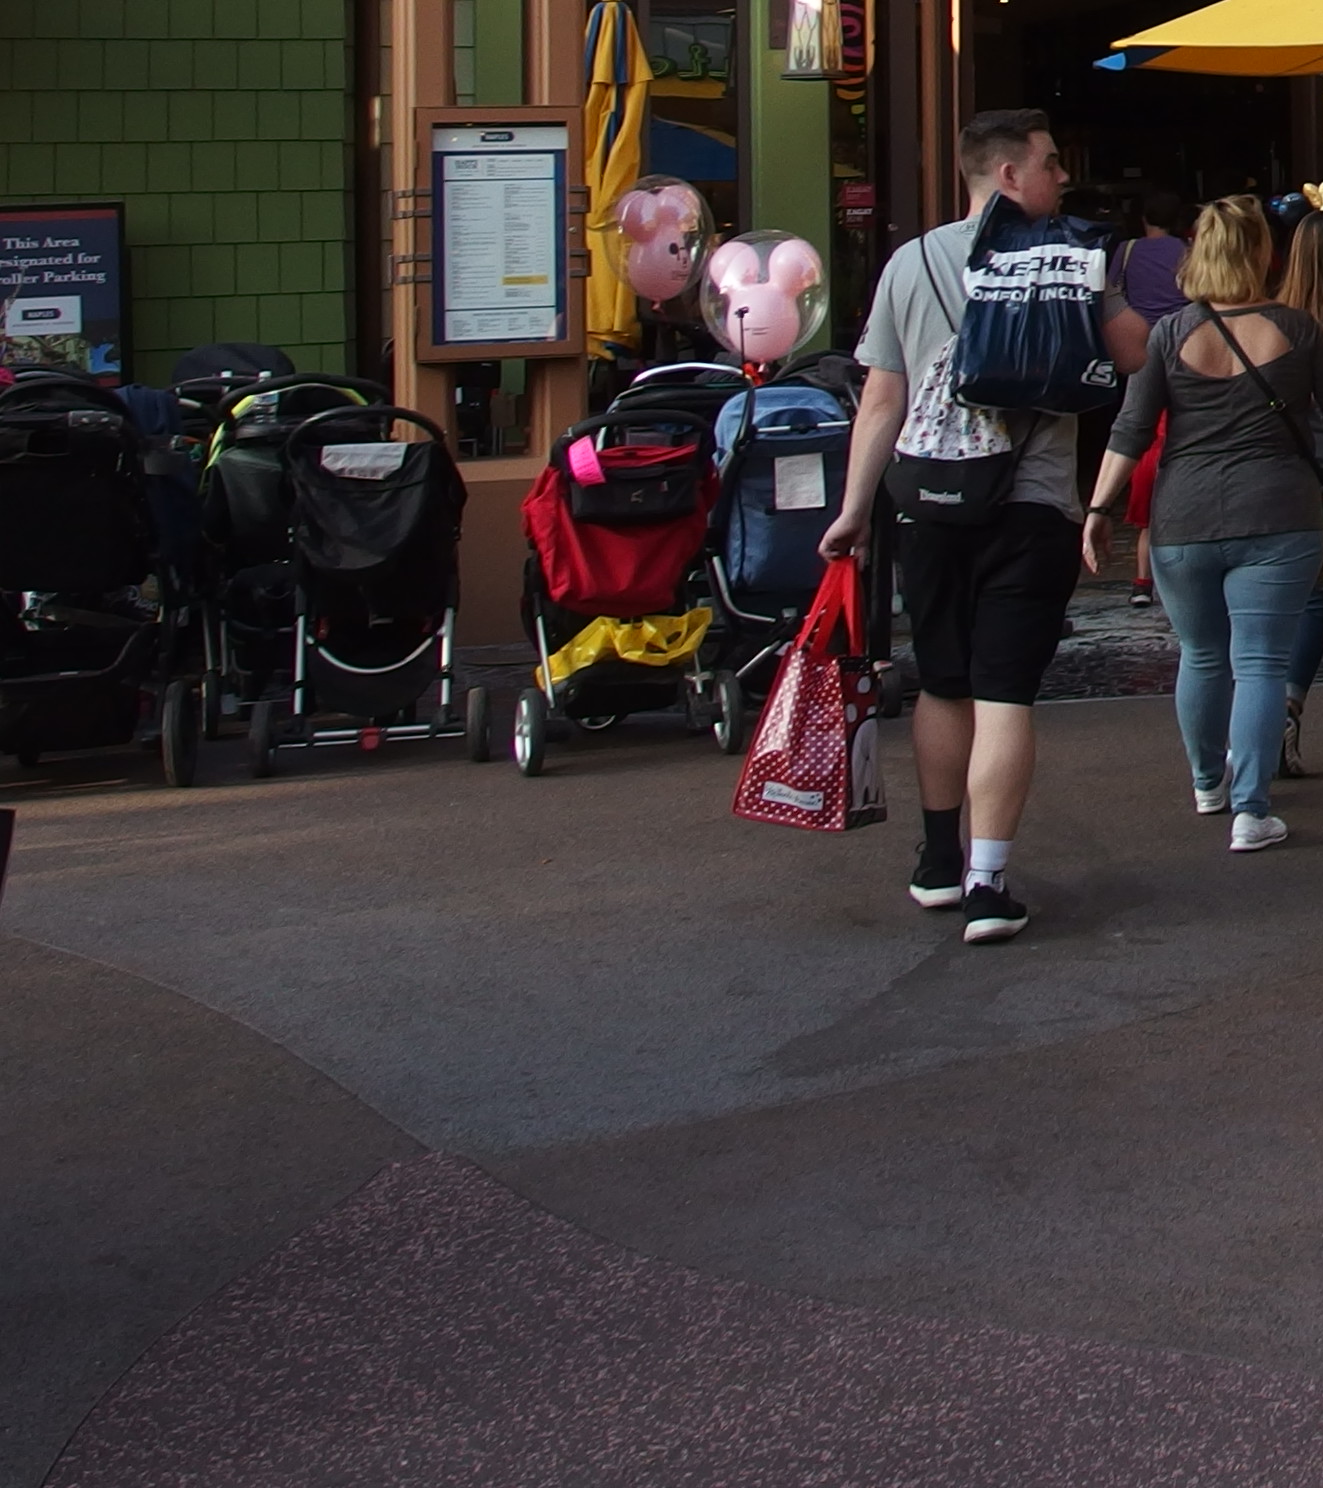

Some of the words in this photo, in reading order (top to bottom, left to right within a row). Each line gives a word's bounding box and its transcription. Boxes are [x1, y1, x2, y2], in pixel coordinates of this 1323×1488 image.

[3, 237, 39, 250] This
[42, 236, 80, 248] Area
[77, 252, 101, 265] for
[43, 270, 107, 284] Parking
